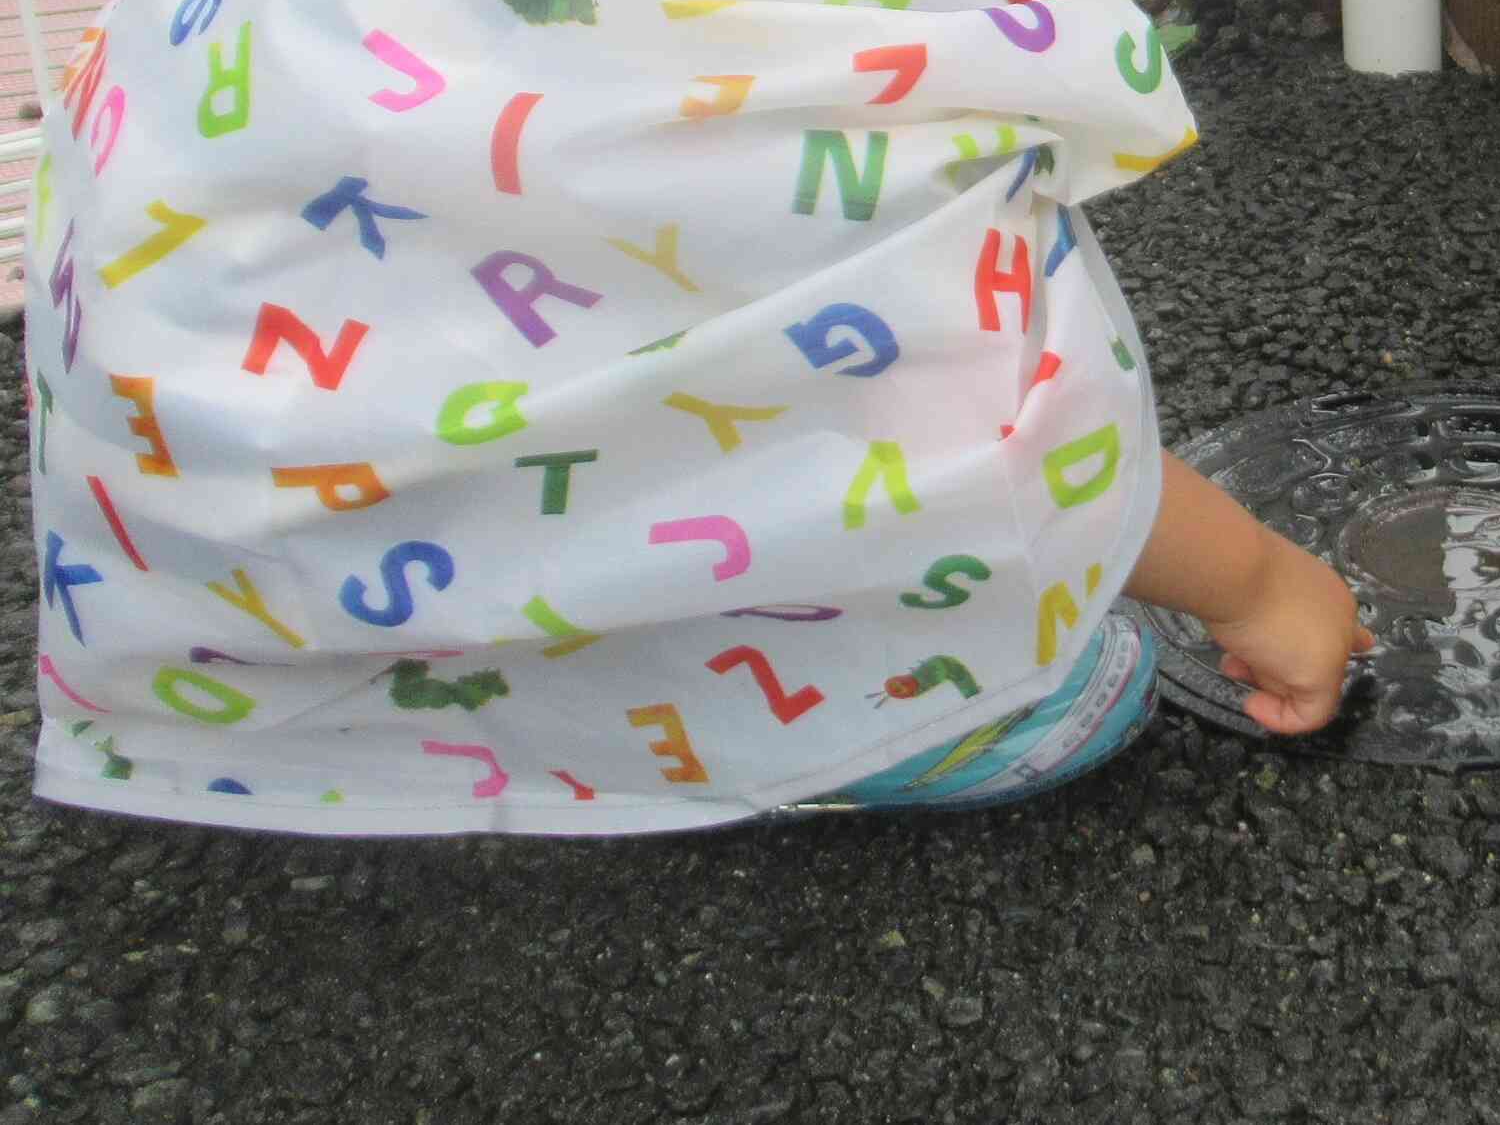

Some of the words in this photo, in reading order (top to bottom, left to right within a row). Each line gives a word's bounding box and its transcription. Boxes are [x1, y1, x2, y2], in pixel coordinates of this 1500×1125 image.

[197, 21, 253, 139] R
[300, 176, 430, 261] K
[793, 129, 889, 228] N
[470, 250, 604, 349] R
[974, 227, 1033, 334] H
[109, 374, 181, 477] E
[662, 391, 790, 456] Y
[269, 461, 396, 513] P
[514, 448, 600, 516] T
[44, 530, 104, 647] K
[205, 566, 306, 650] Y
[340, 540, 455, 629] S
[898, 555, 993, 611] S
[627, 703, 710, 784] E
